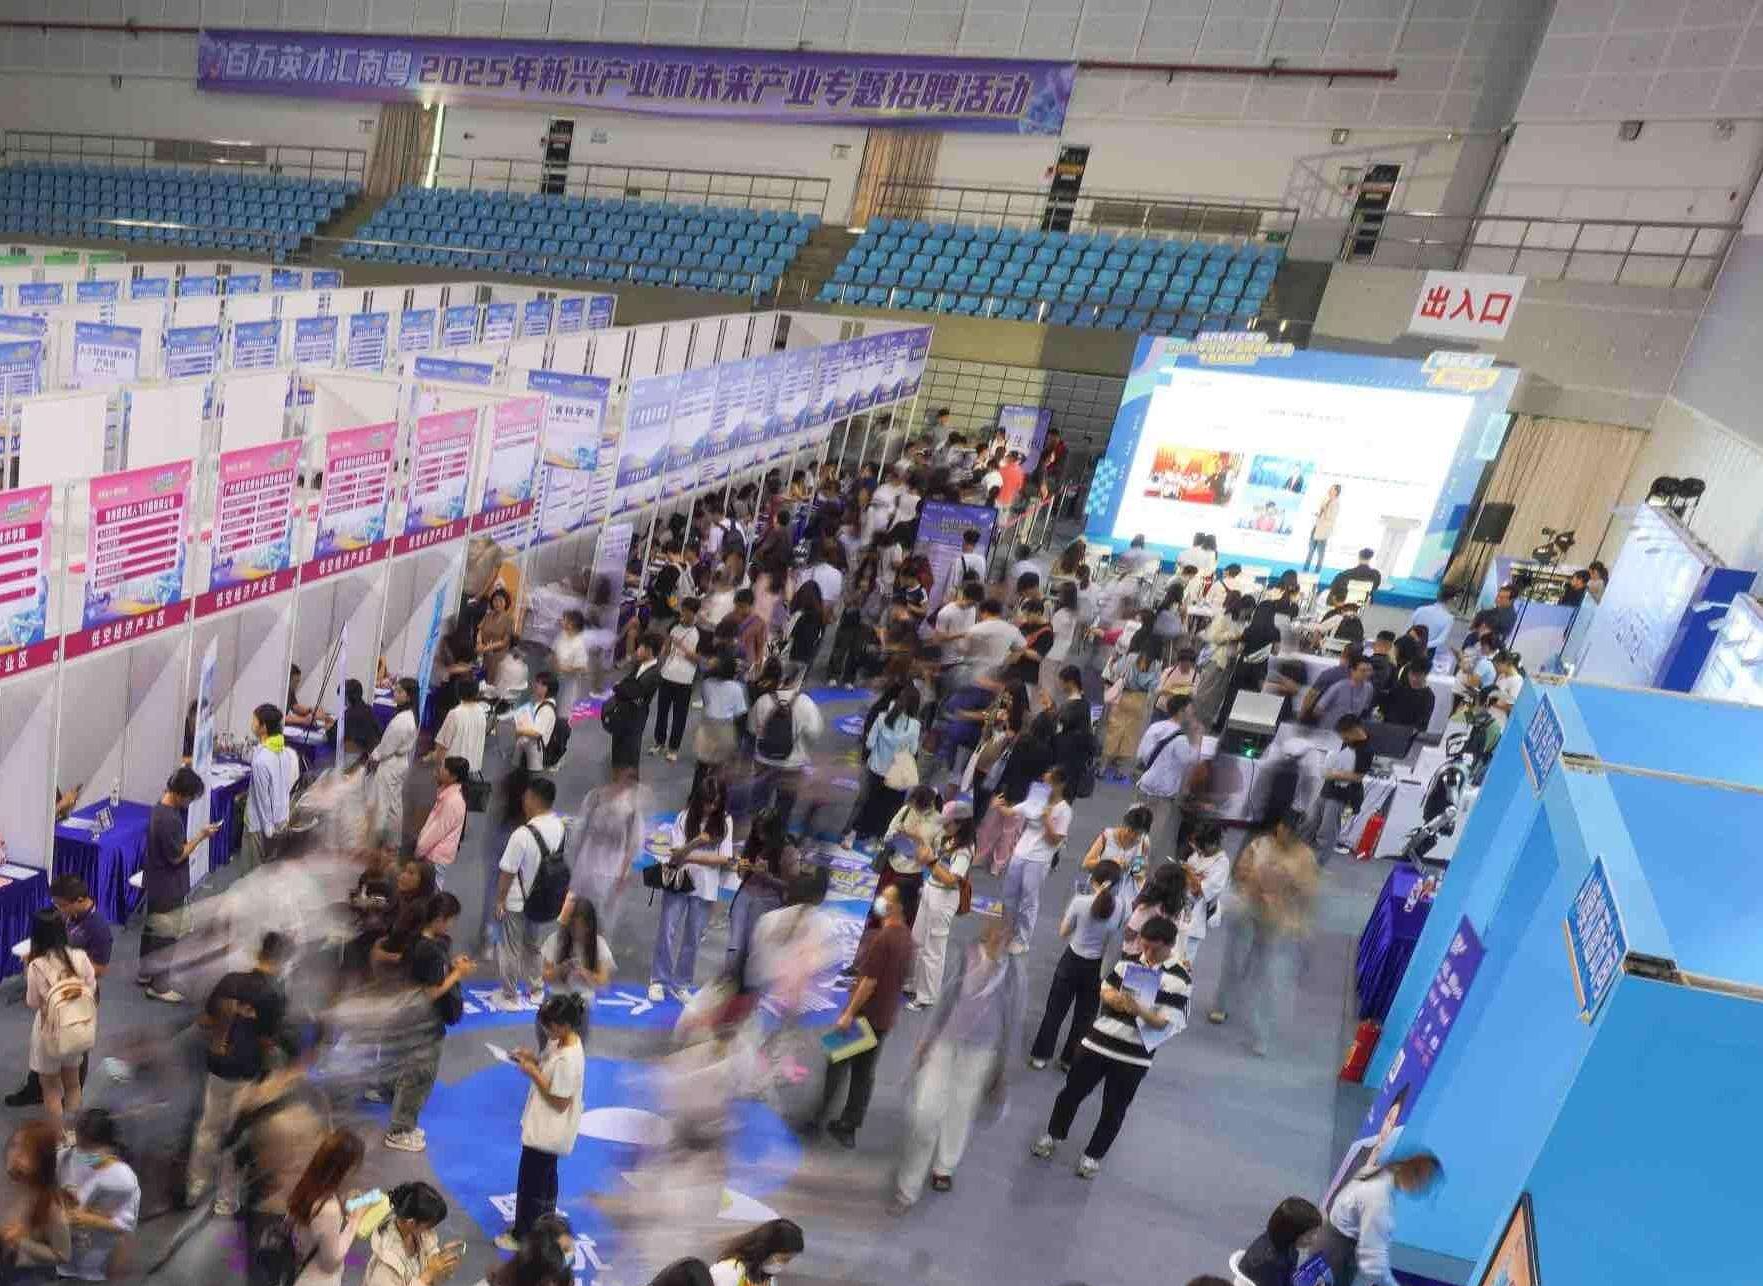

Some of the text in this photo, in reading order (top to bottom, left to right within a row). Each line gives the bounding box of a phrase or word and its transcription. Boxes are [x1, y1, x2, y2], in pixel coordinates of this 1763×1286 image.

[223, 41, 1031, 114] 百万英才汇南粤 2025年新兴产业和未来产业专题招聘活动
[1418, 284, 1513, 326] 出入口
[91, 610, 167, 648] 低空经济产业区
